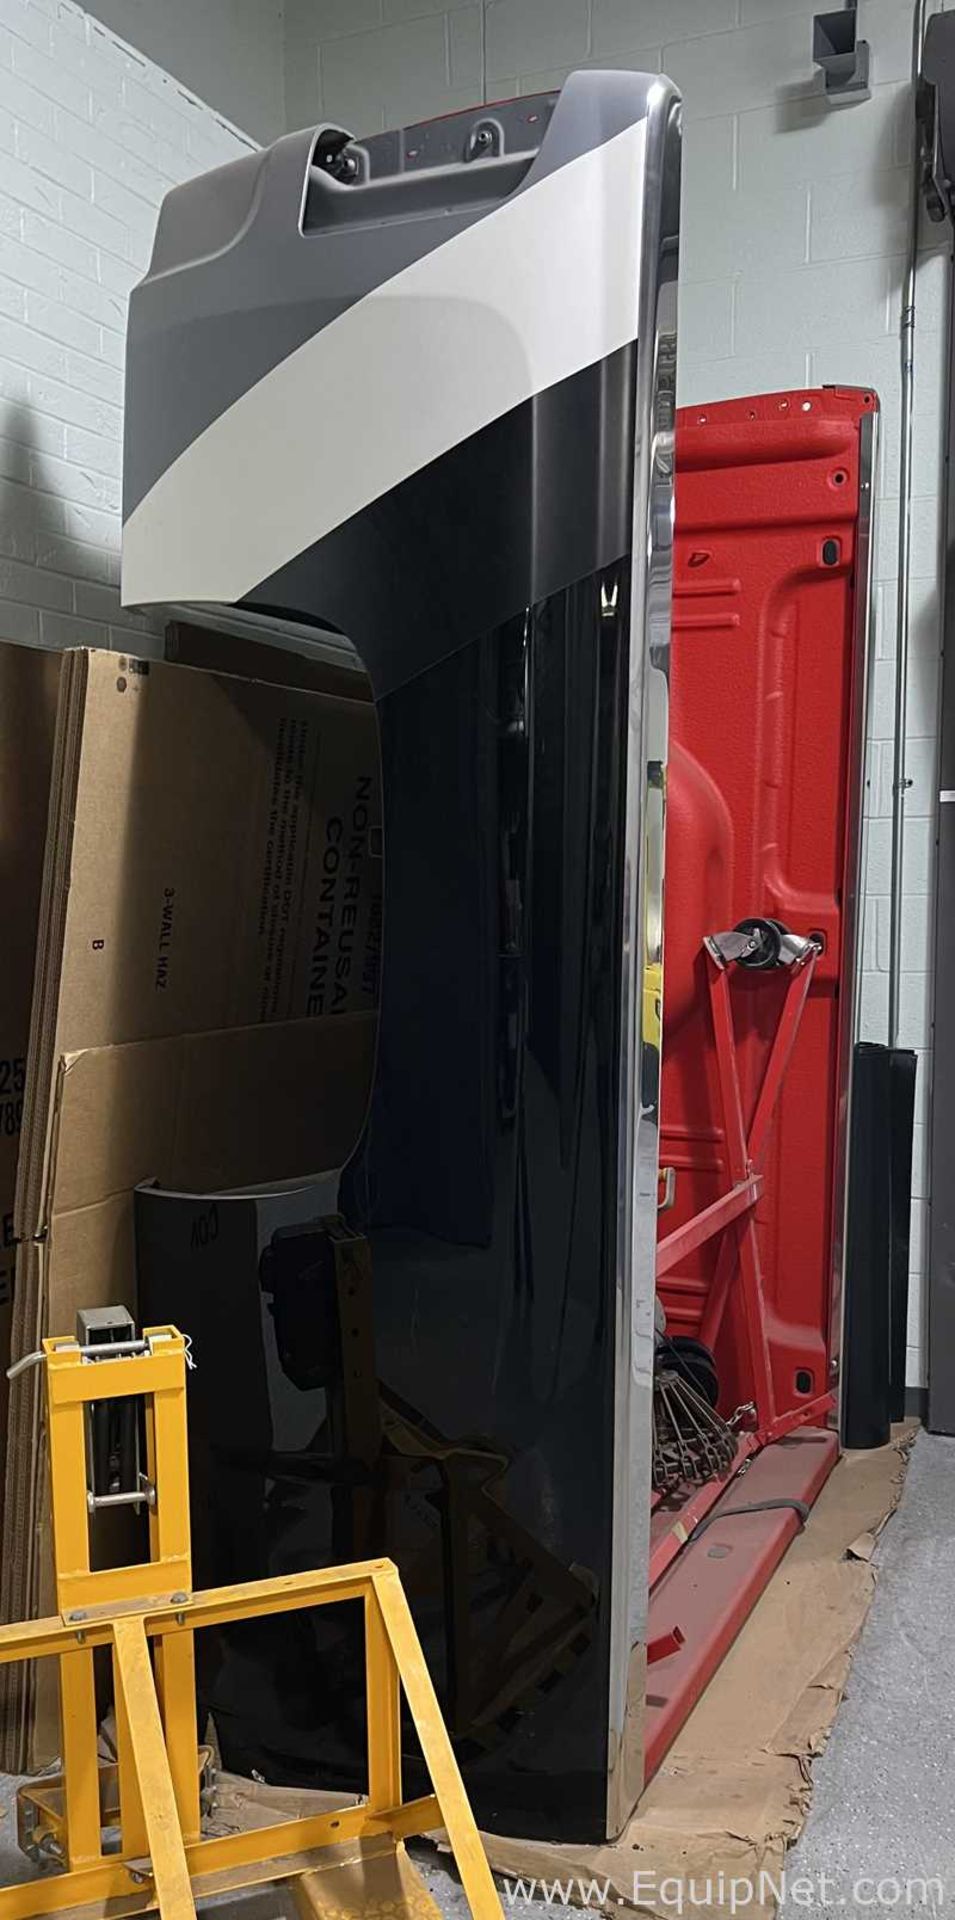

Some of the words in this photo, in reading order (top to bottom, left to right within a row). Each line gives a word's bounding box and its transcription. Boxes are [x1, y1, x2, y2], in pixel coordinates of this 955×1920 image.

[159, 888, 175, 952] 3-WALL
[92, 939, 105, 950] B
[156, 956, 168, 992] HAZ
